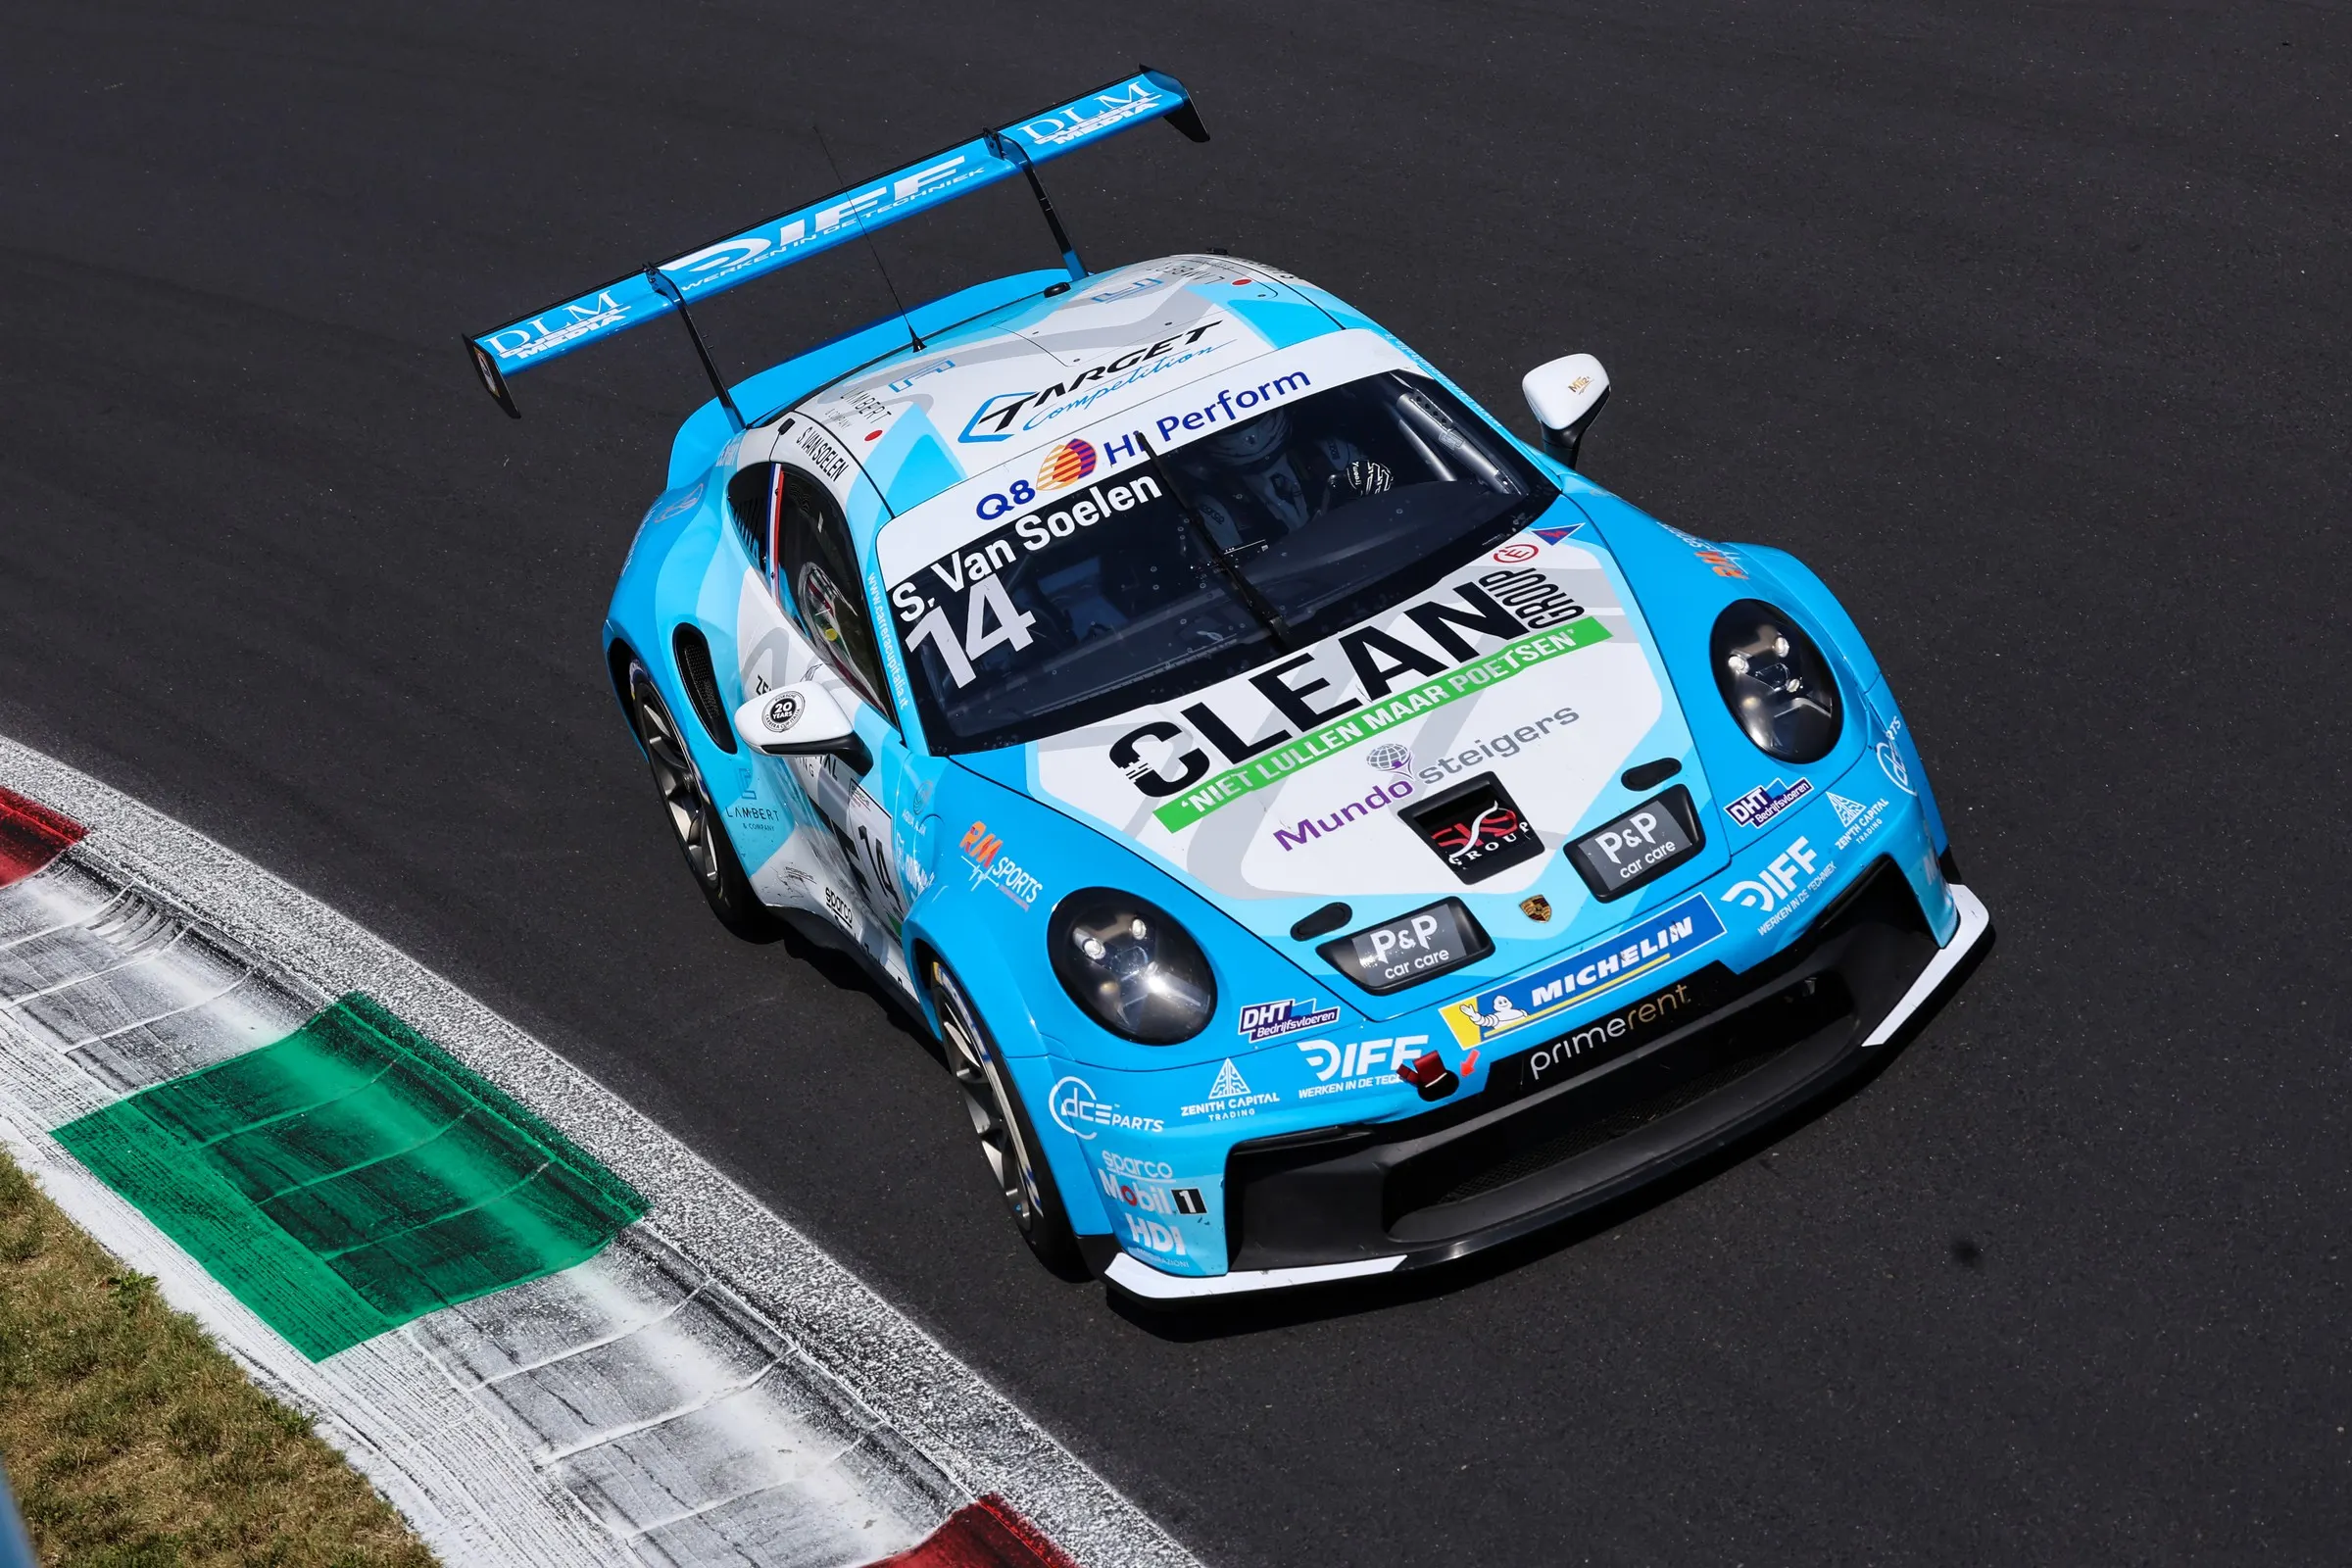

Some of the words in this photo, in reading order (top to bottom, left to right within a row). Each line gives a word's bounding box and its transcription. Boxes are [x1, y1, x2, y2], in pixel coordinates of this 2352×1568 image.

[1016, 81, 1154, 140] DLM
[1054, 102, 1159, 144] MEDIA
[658, 155, 965, 272] DIFF
[681, 245, 787, 290] WERKEN
[793, 233, 816, 247] IN
[823, 219, 857, 235] DE
[860, 167, 985, 219] TECHNIEK
[484, 290, 623, 356] DLM
[518, 315, 626, 359] MEDIA
[977, 319, 1223, 432] TARGET
[1022, 339, 1238, 431] Competition
[802, 431, 825, 458] VAN
[812, 442, 849, 482] SOELEN
[975, 479, 1036, 520] Q8
[1156, 371, 1311, 442] Perform
[930, 539, 1016, 593] Van
[1014, 475, 1163, 551] Soelen
[1478, 567, 1585, 628] GROUP
[867, 572, 908, 710] www.carreracupitalia.it
[905, 573, 1036, 689] 14
[774, 702, 793, 713] 20
[1108, 581, 1531, 799] CLEAN
[772, 710, 793, 720] YEARS
[1261, 721, 1361, 783] LULLEN
[1367, 685, 1447, 733] MAAR
[1273, 780, 1414, 852] Mundo
[1418, 707, 1580, 784] steigers
[725, 807, 779, 821] LAMBERT
[1730, 788, 1768, 822] DHT
[1755, 782, 1810, 823] Bedrijfsvloeren
[1858, 798, 1889, 826] CAPITAL
[959, 820, 1004, 868] RM
[1448, 821, 1530, 865] GROUP
[1594, 812, 1657, 864] P&P
[1855, 818, 1883, 844] TRADING
[992, 857, 1043, 904] SPORTS
[1620, 858, 1643, 878] car
[1644, 841, 1677, 864] care
[1720, 836, 1817, 911] DIFF
[825, 887, 854, 924] sparco
[1757, 905, 1792, 936] WERKEN
[1789, 897, 1800, 910] IN
[1370, 914, 1438, 964] P&P
[1385, 961, 1410, 979] car
[1414, 949, 1450, 969] care
[1532, 916, 1693, 1007] MICHELIN
[1243, 1001, 1295, 1029] DHT
[1257, 1012, 1335, 1038] Bedrijfsvloeren
[1530, 983, 1691, 1080] primerent
[1297, 1035, 1429, 1081] DIFF
[1180, 1101, 1225, 1116] ZENITH
[1228, 1093, 1280, 1108] CAPITAL
[1298, 1083, 1344, 1099] WERKEN
[1345, 1080, 1357, 1090] IN
[1357, 1077, 1374, 1088] DE
[1112, 1113, 1164, 1132] PARTS
[1208, 1108, 1255, 1121] TRADING
[1102, 1150, 1173, 1179] sparco
[1098, 1167, 1173, 1215] Mobil
[1178, 1190, 1197, 1213] 1
[1124, 1212, 1187, 1255] HDI
